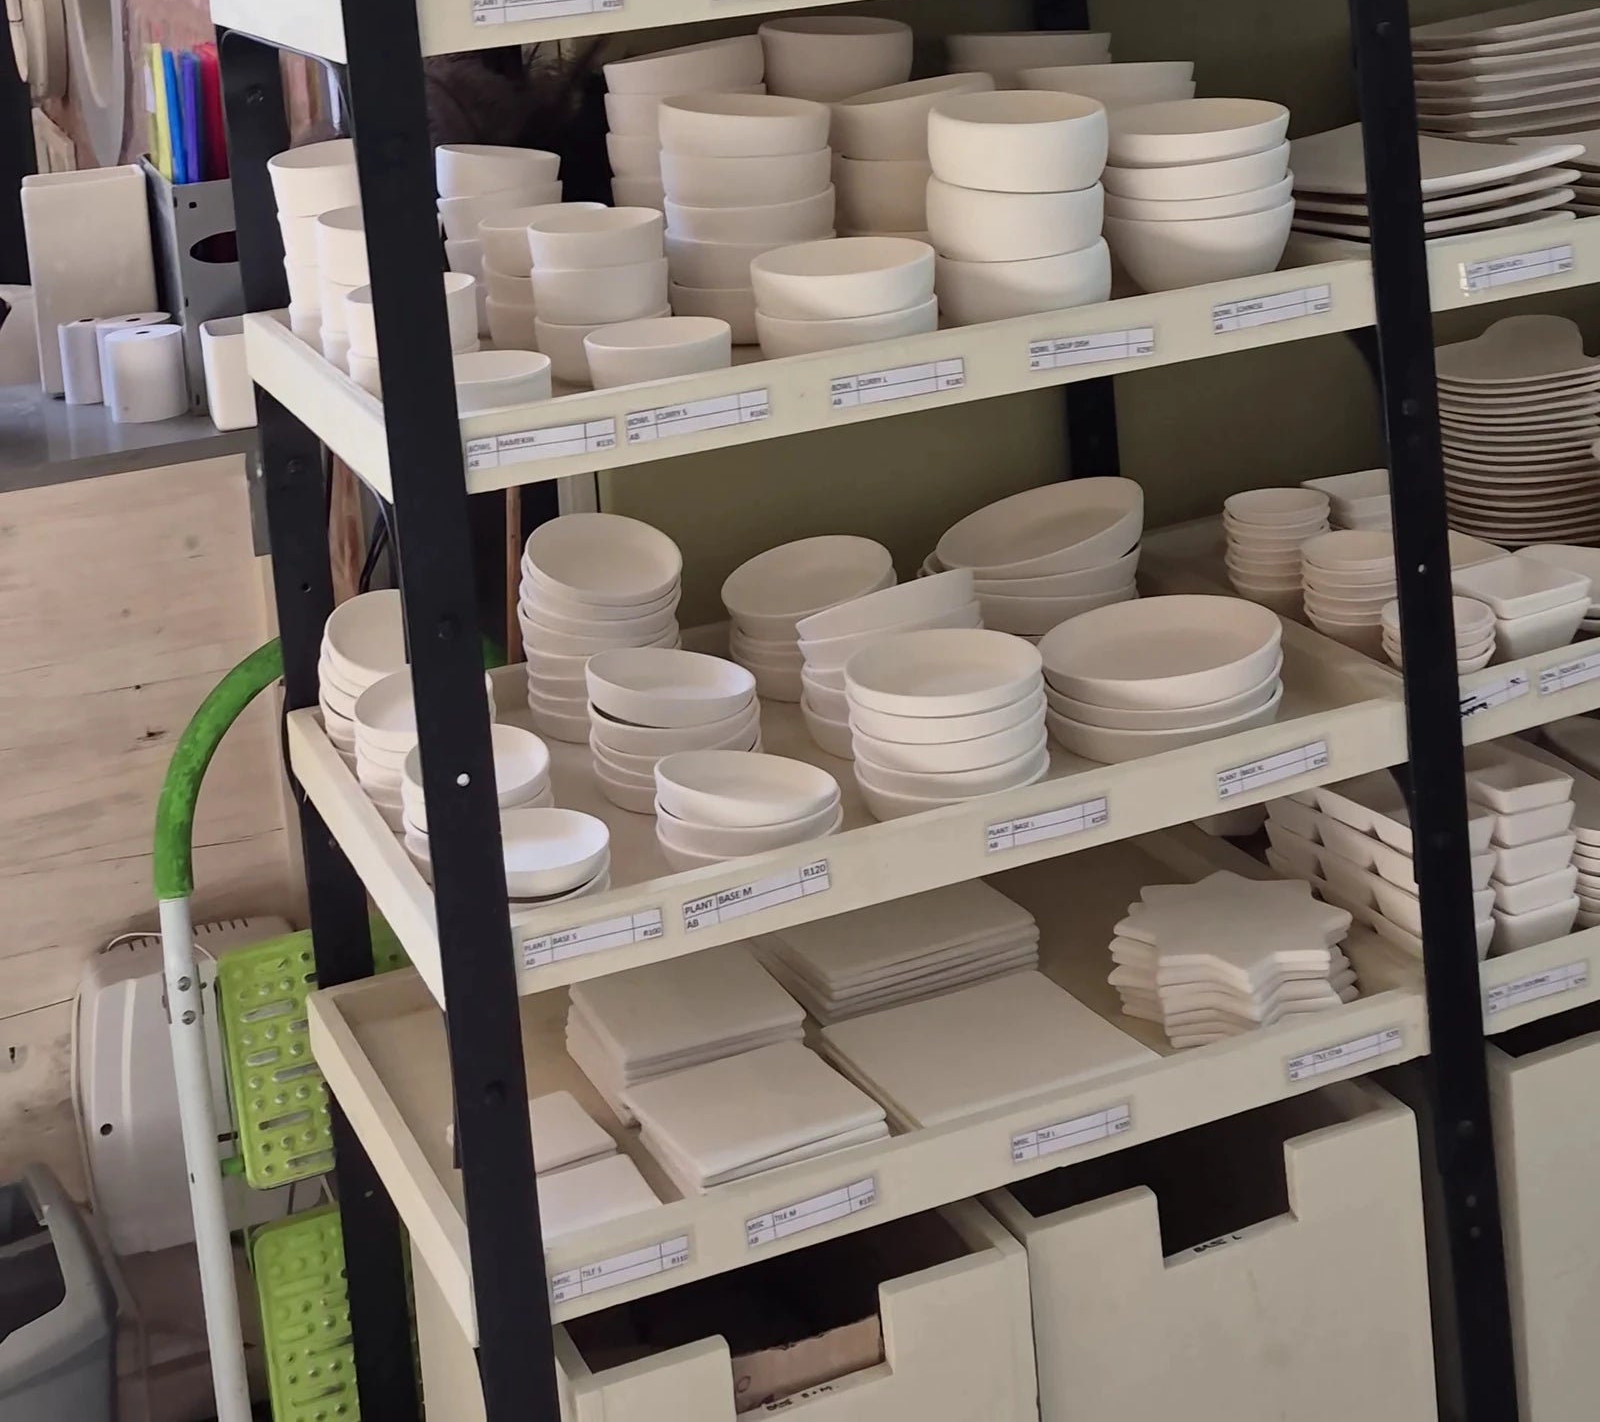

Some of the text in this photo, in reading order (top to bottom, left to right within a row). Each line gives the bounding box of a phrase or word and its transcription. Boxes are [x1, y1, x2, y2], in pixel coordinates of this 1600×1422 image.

[831, 382, 853, 392] BOWL
[859, 377, 882, 387] CURRY
[628, 416, 650, 427] BOWL
[656, 410, 681, 421] CURRY
[468, 443, 491, 453] BOWL
[1218, 772, 1237, 782] PLANT
[988, 826, 1009, 836] PLANT
[1013, 821, 1030, 831] BASE
[684, 864, 826, 915] PLANT BASE M R120
[686, 919, 699, 929] AB
[524, 940, 547, 952] PLANT
[552, 934, 570, 945] BASE
[1013, 1137, 1030, 1147] MISC
[747, 1209, 797, 1231] MISC TILE M
[552, 1275, 571, 1285] MISC
[581, 1268, 595, 1278] TILE
